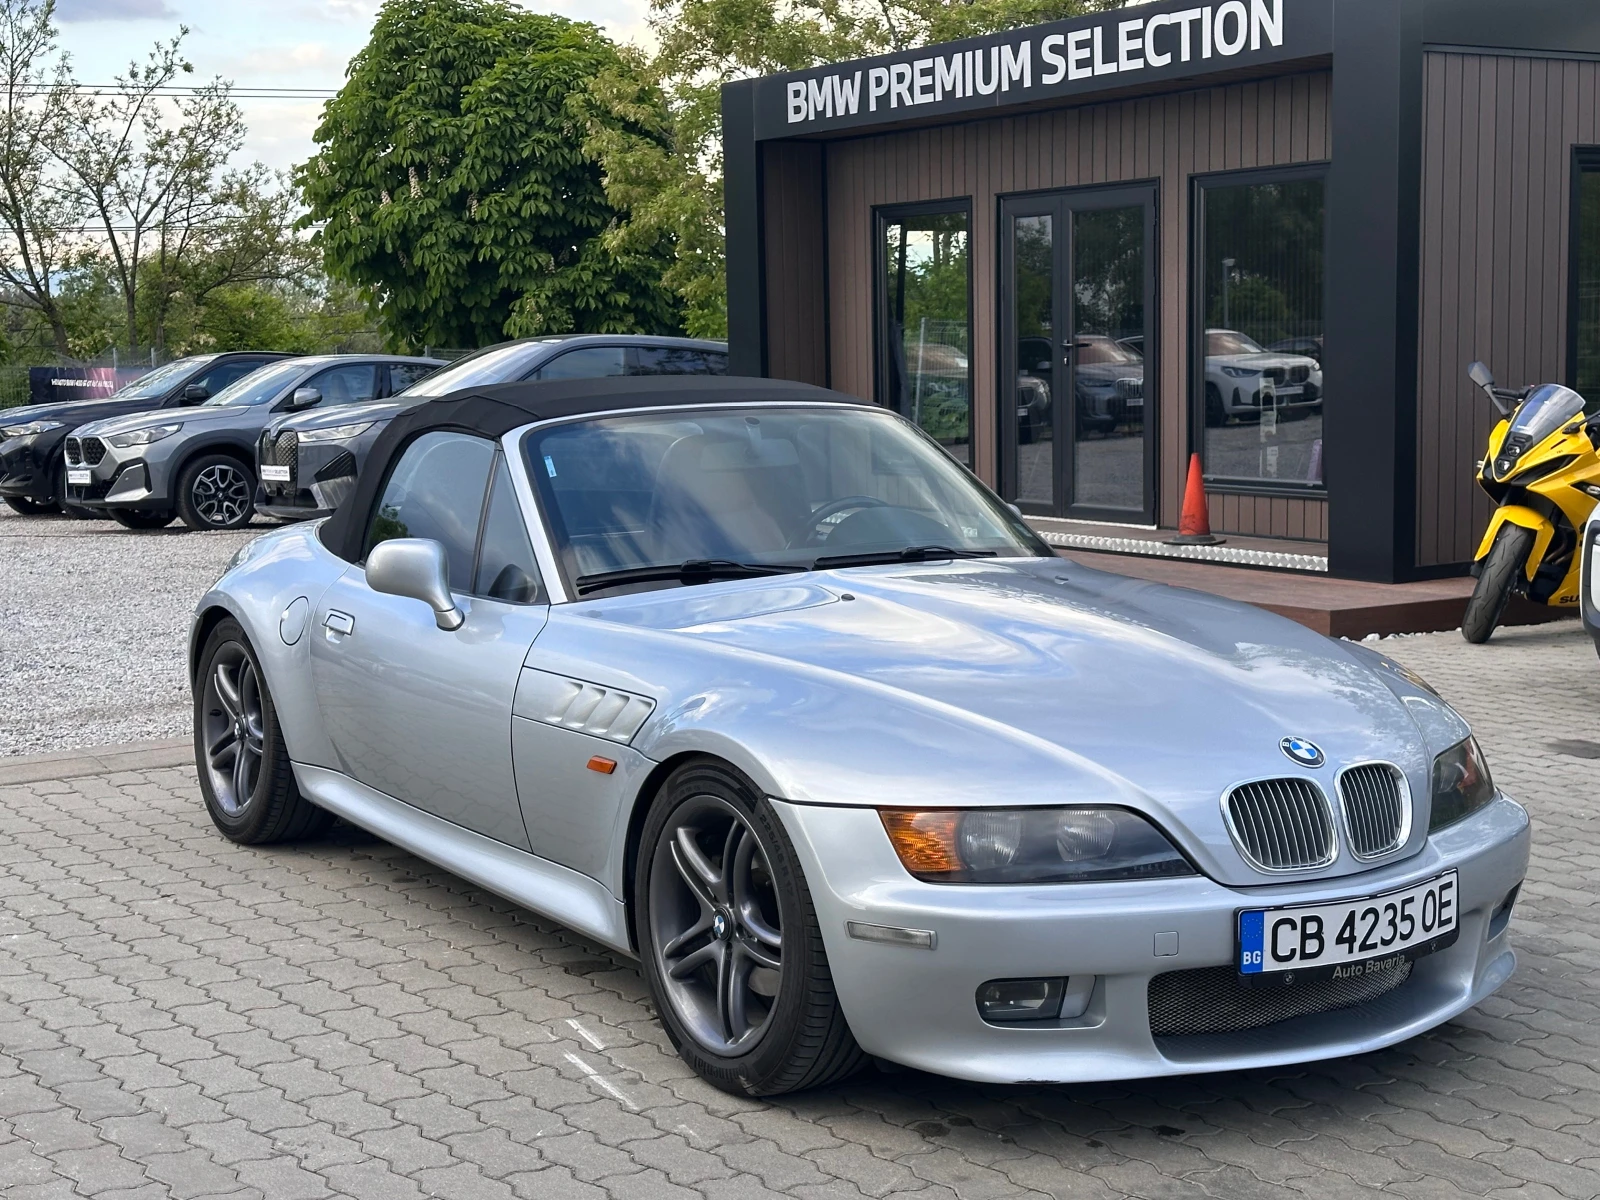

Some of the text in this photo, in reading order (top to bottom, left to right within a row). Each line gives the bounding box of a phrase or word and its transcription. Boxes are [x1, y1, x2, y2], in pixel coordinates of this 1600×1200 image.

[787, 0, 1283, 123] BMW PREMIUM SELECTION
[1271, 915, 1325, 962] CB
[1335, 896, 1415, 954] 4235
[1243, 951, 1262, 965] BG
[1332, 953, 1405, 979] Auto Bavaria
